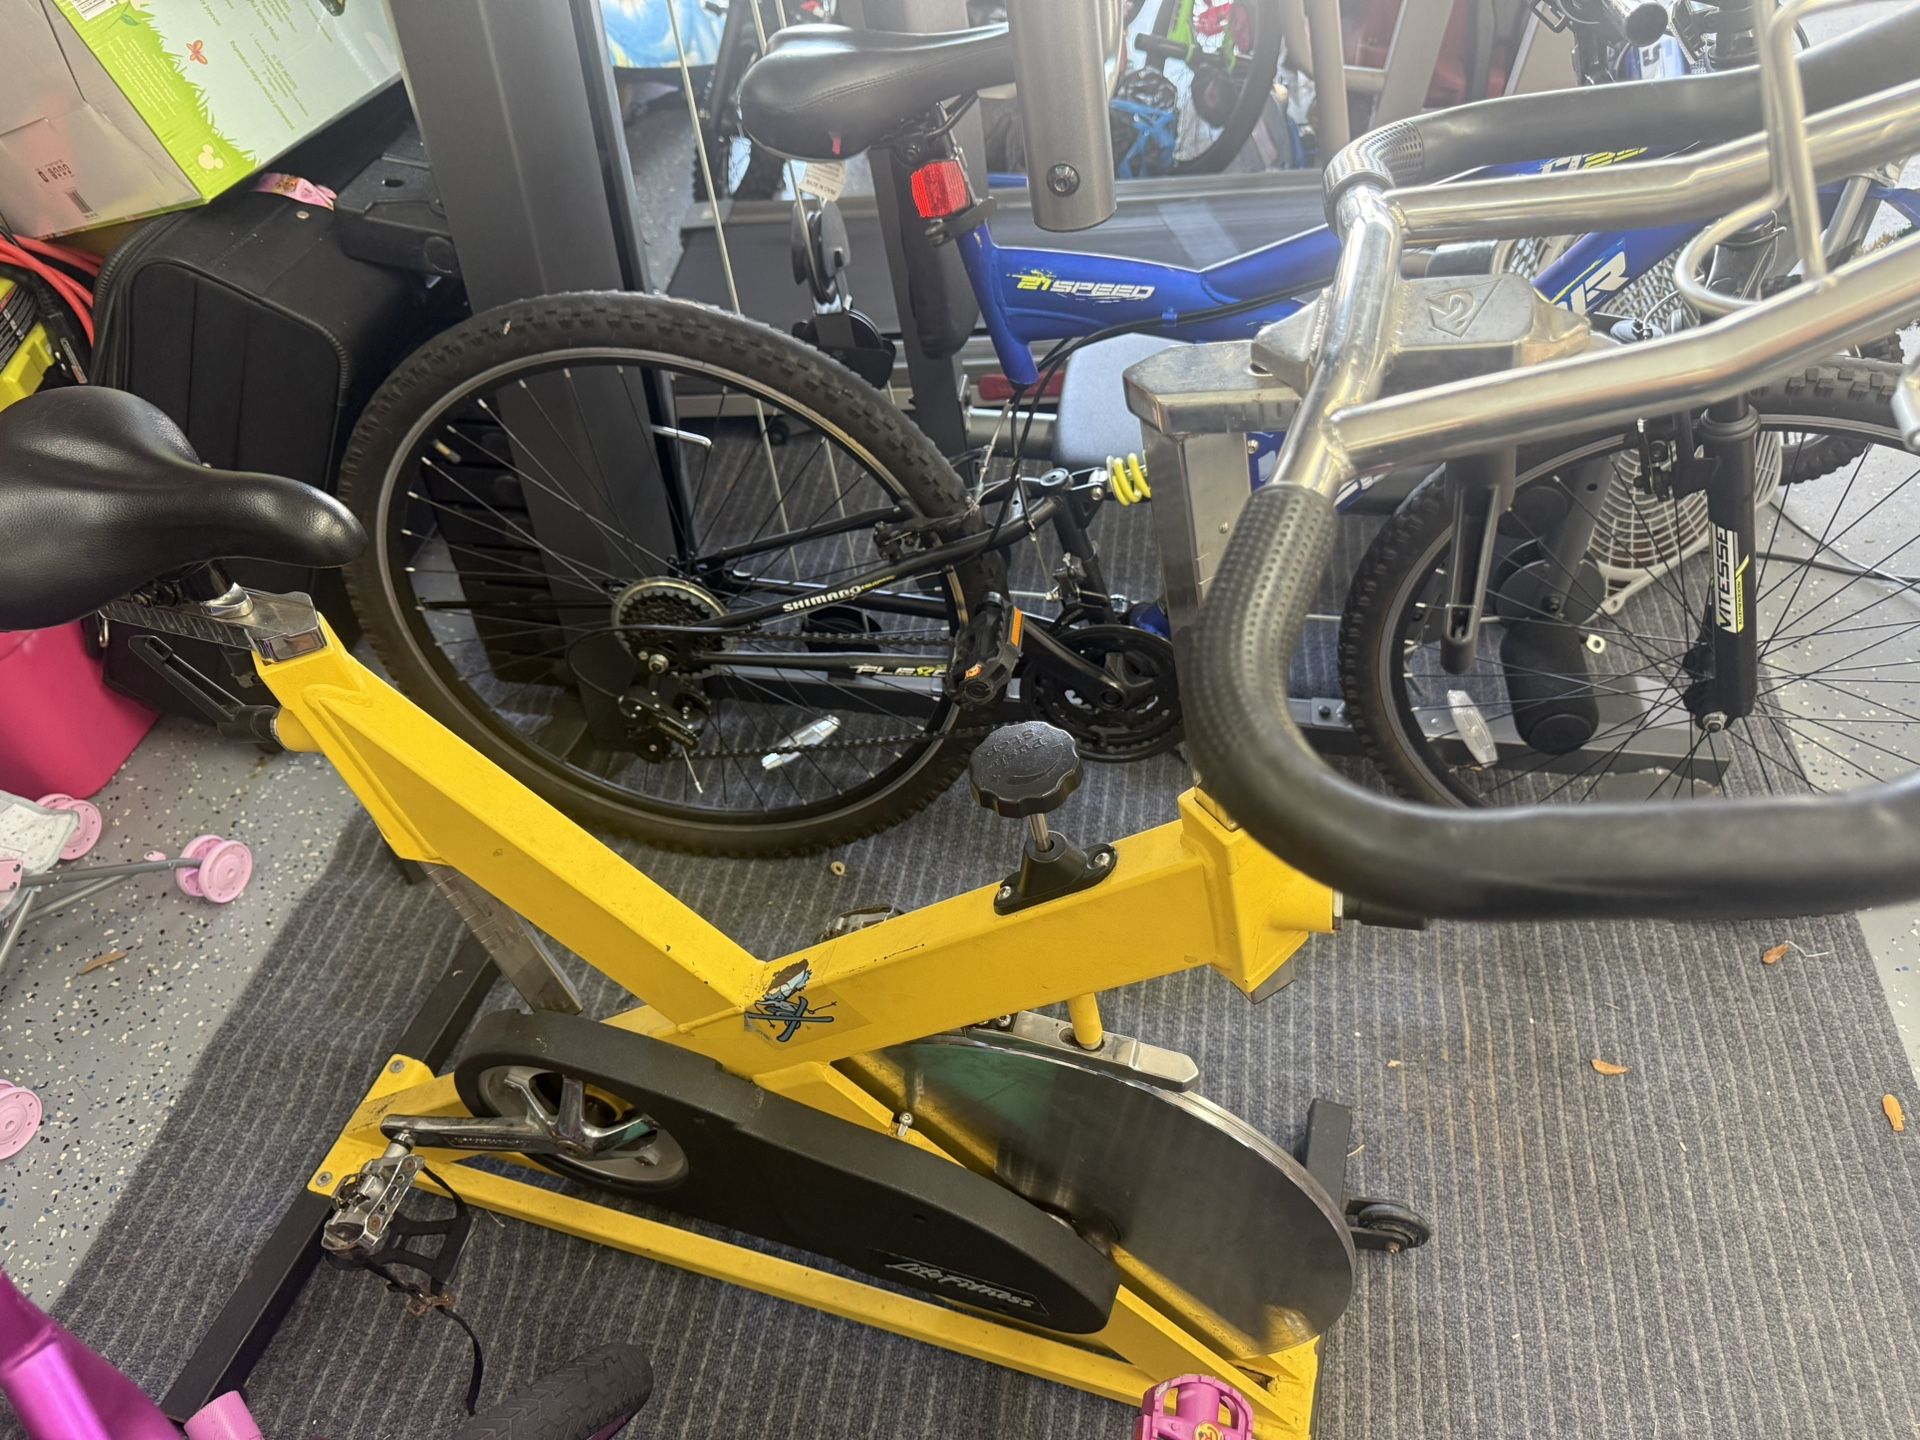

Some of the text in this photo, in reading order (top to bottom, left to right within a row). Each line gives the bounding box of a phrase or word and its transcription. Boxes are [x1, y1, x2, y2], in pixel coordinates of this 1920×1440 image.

[1017, 277, 1156, 298] 21 SPEED
[1715, 524, 1731, 627] VITESSE
[781, 584, 861, 613] SHIMANO
[885, 1261, 1034, 1308] Life Fitness
